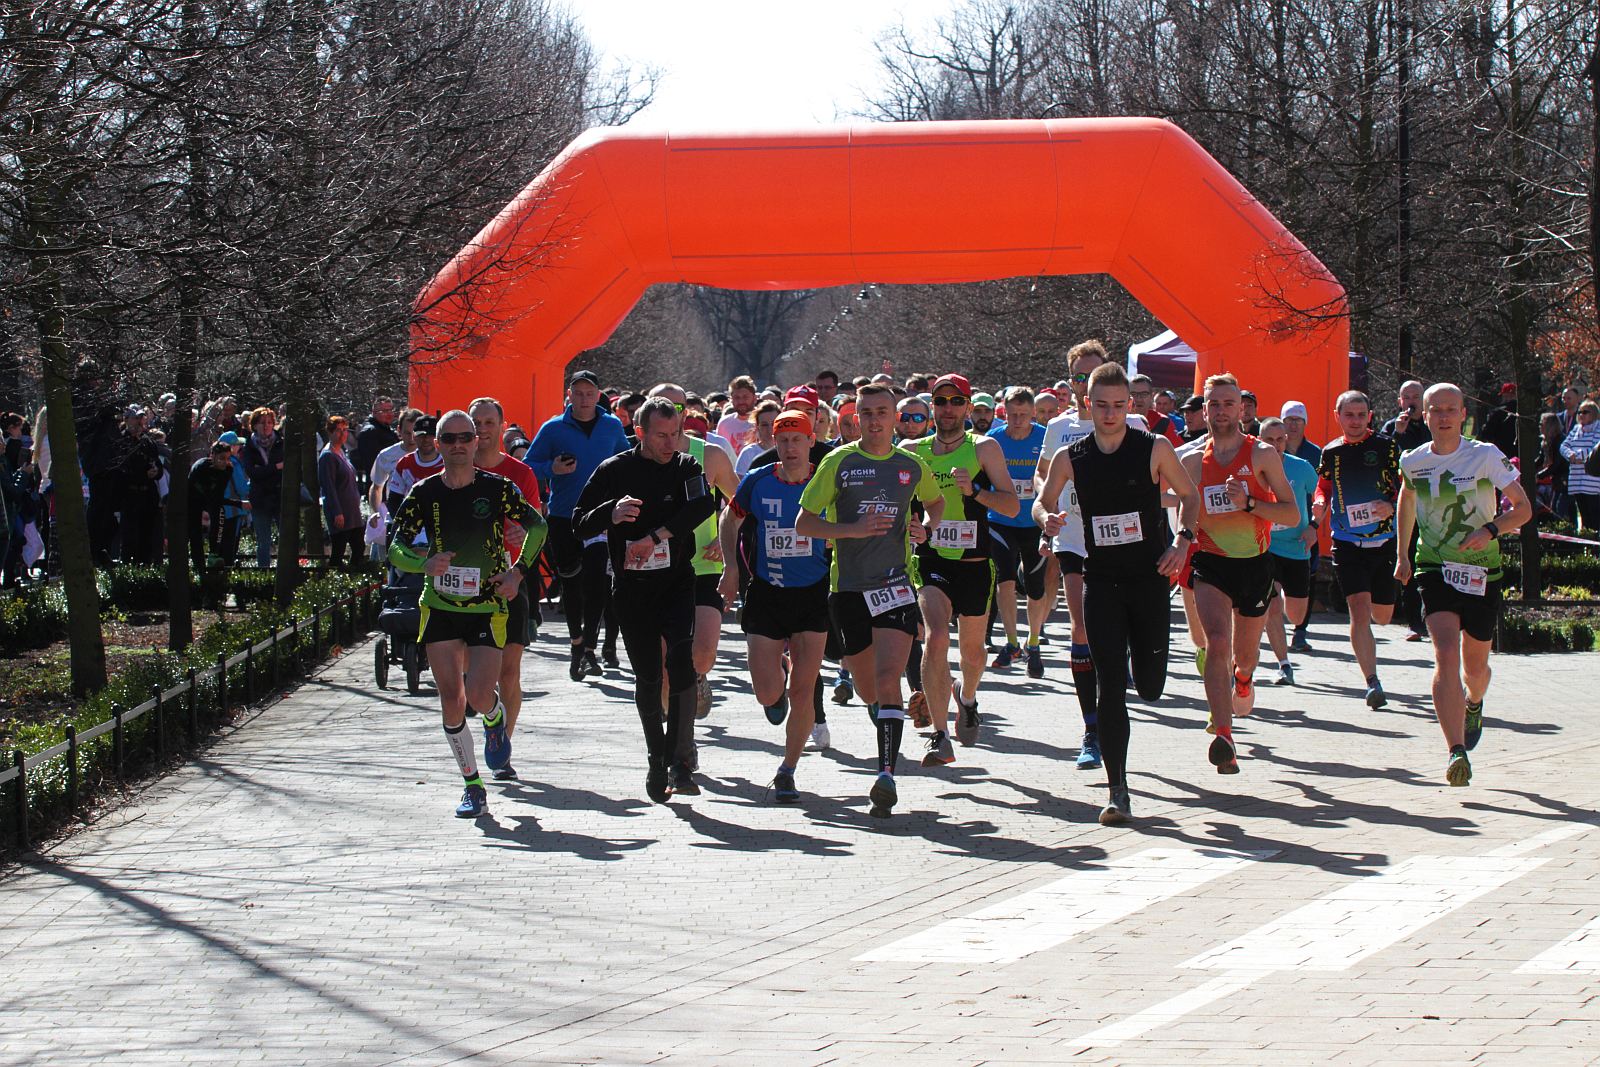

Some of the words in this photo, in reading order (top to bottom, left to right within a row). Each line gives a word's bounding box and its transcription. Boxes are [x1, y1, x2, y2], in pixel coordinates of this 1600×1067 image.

[850, 468, 876, 476] KGHM
[1208, 491, 1231, 507] 156
[1352, 509, 1369, 521] 145
[936, 527, 958, 541] 140
[1098, 523, 1120, 538] 115
[769, 535, 793, 549] 192
[439, 573, 460, 588] 195
[1444, 569, 1470, 586] 085
[869, 588, 896, 607] 051
